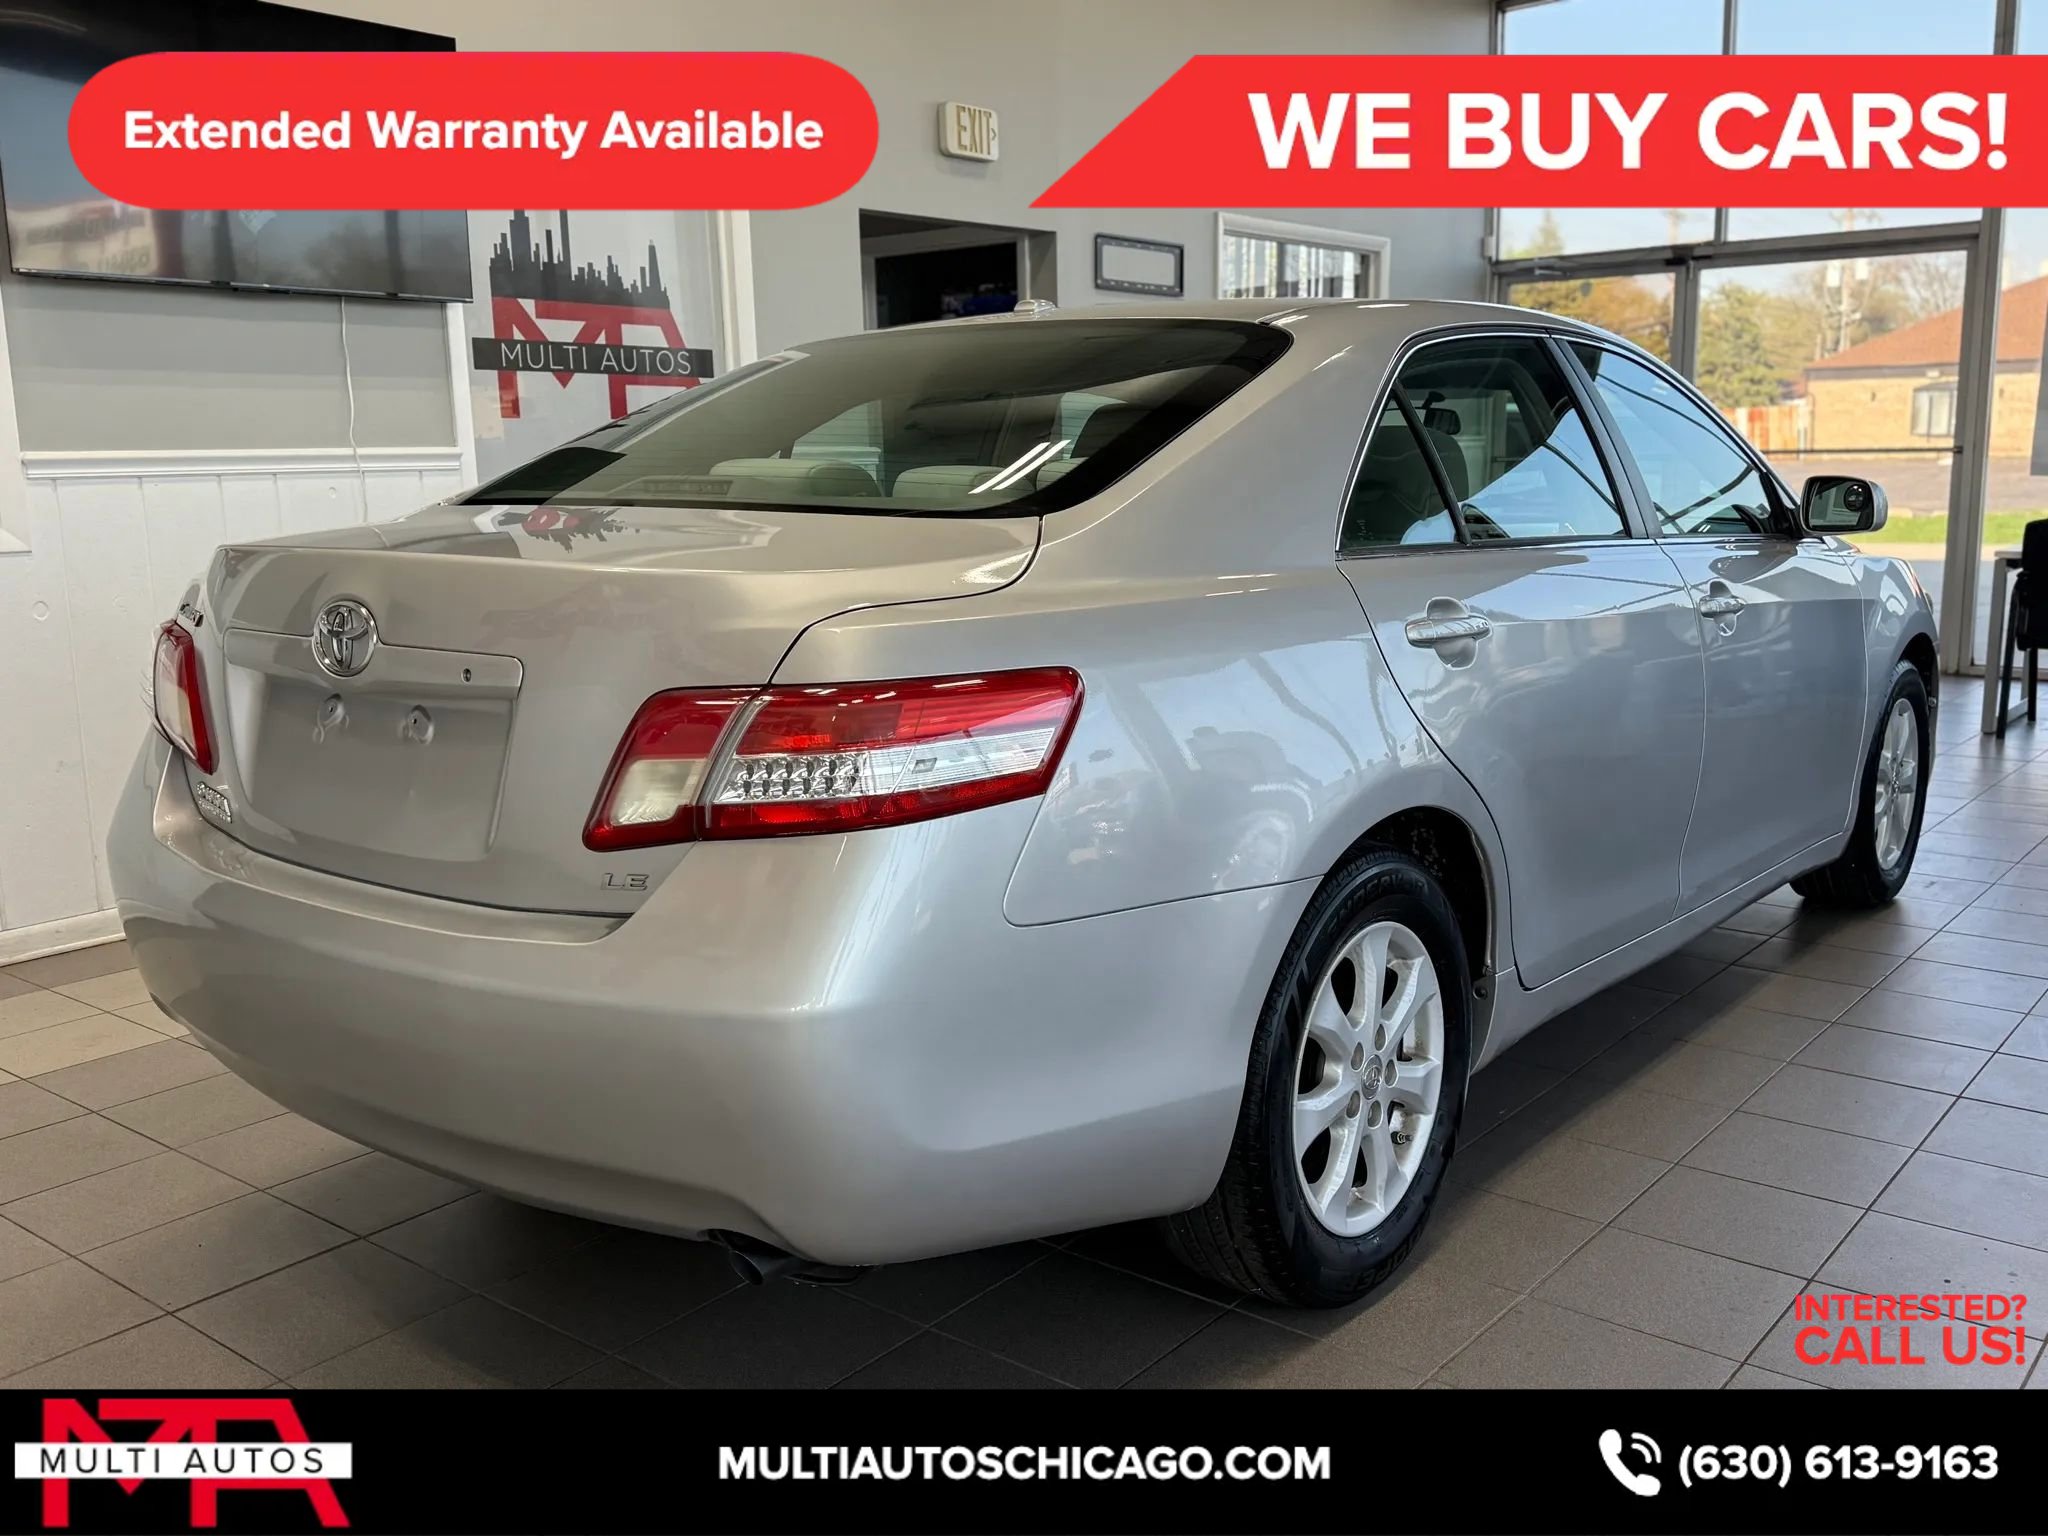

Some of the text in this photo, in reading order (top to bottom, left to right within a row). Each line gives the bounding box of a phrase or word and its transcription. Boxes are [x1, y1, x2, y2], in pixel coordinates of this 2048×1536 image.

[956, 104, 992, 156] EXIT
[501, 342, 692, 374] MULTI AUTOS
[600, 872, 650, 891] LE
